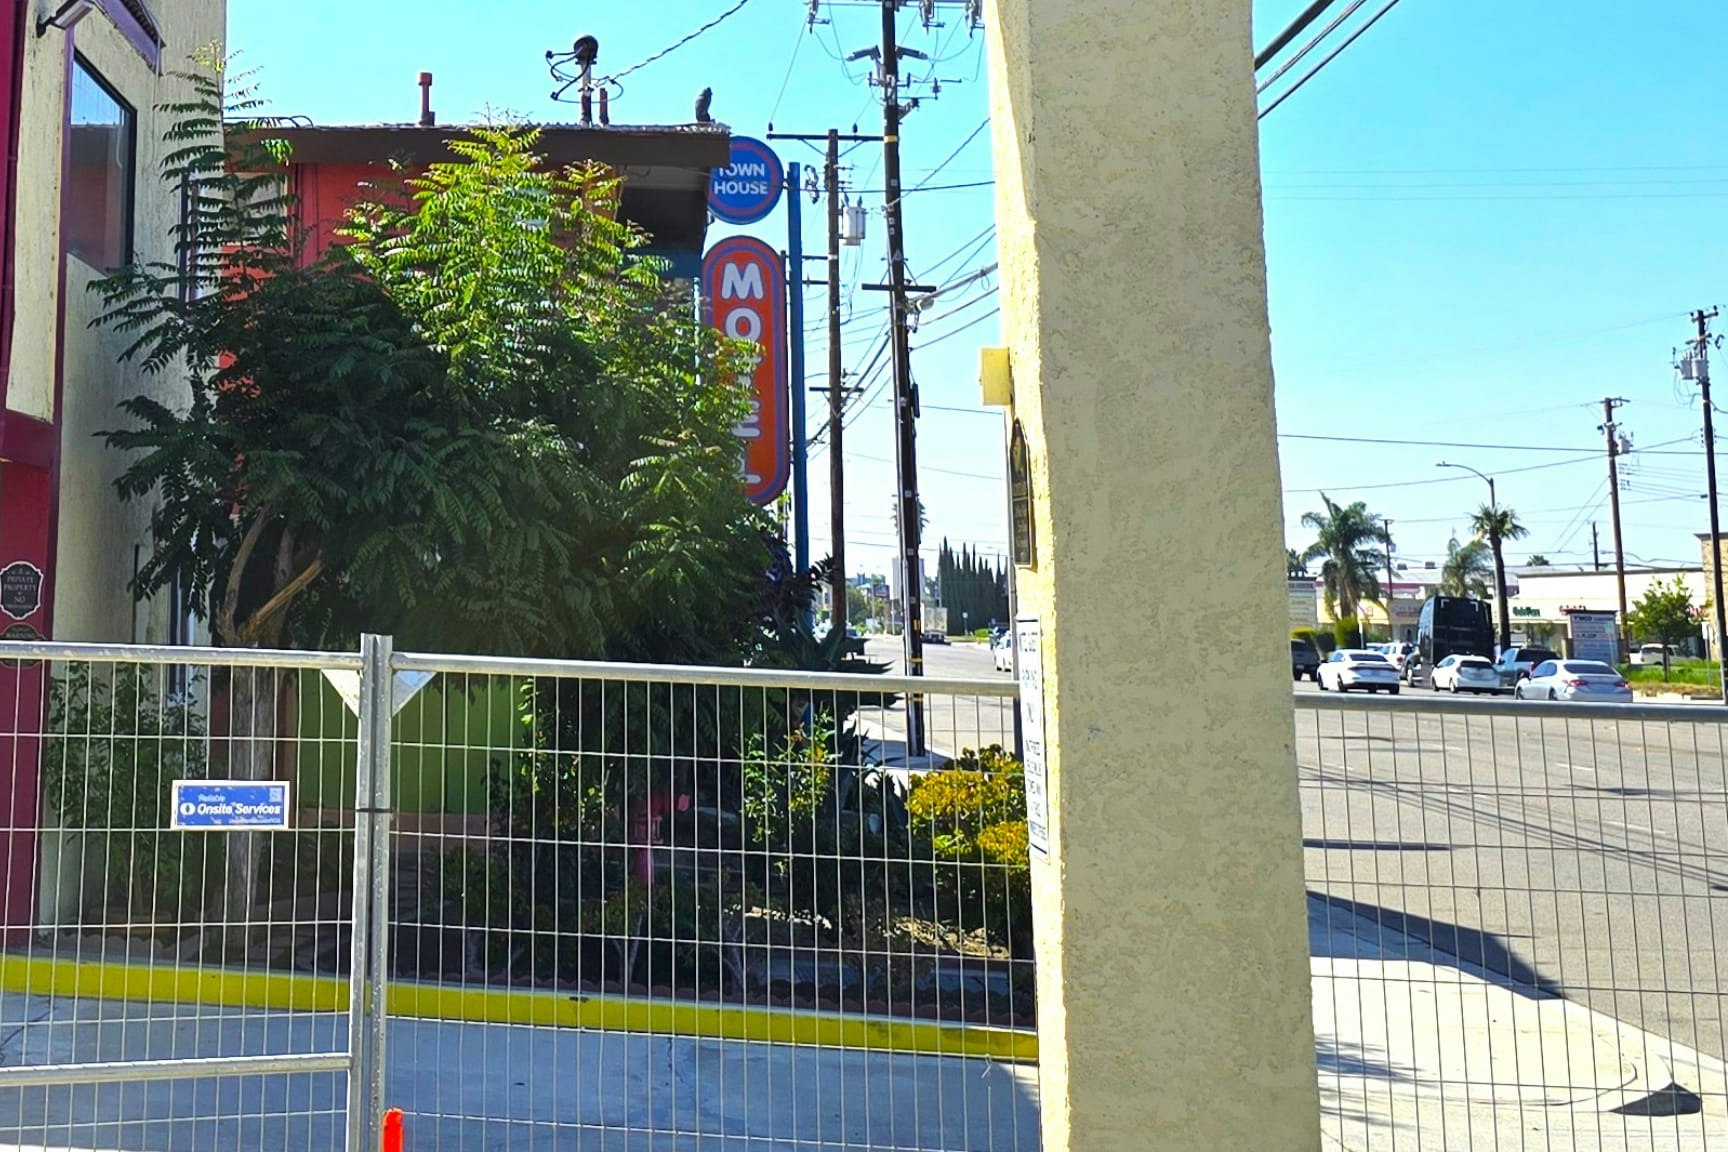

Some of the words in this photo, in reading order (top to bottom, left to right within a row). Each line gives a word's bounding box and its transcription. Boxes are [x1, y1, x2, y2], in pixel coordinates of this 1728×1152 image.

[714, 181, 769, 195] HOUSE
[721, 262, 765, 485] MOEL
[197, 803, 233, 815] Onsite
[235, 803, 281, 815] Services
